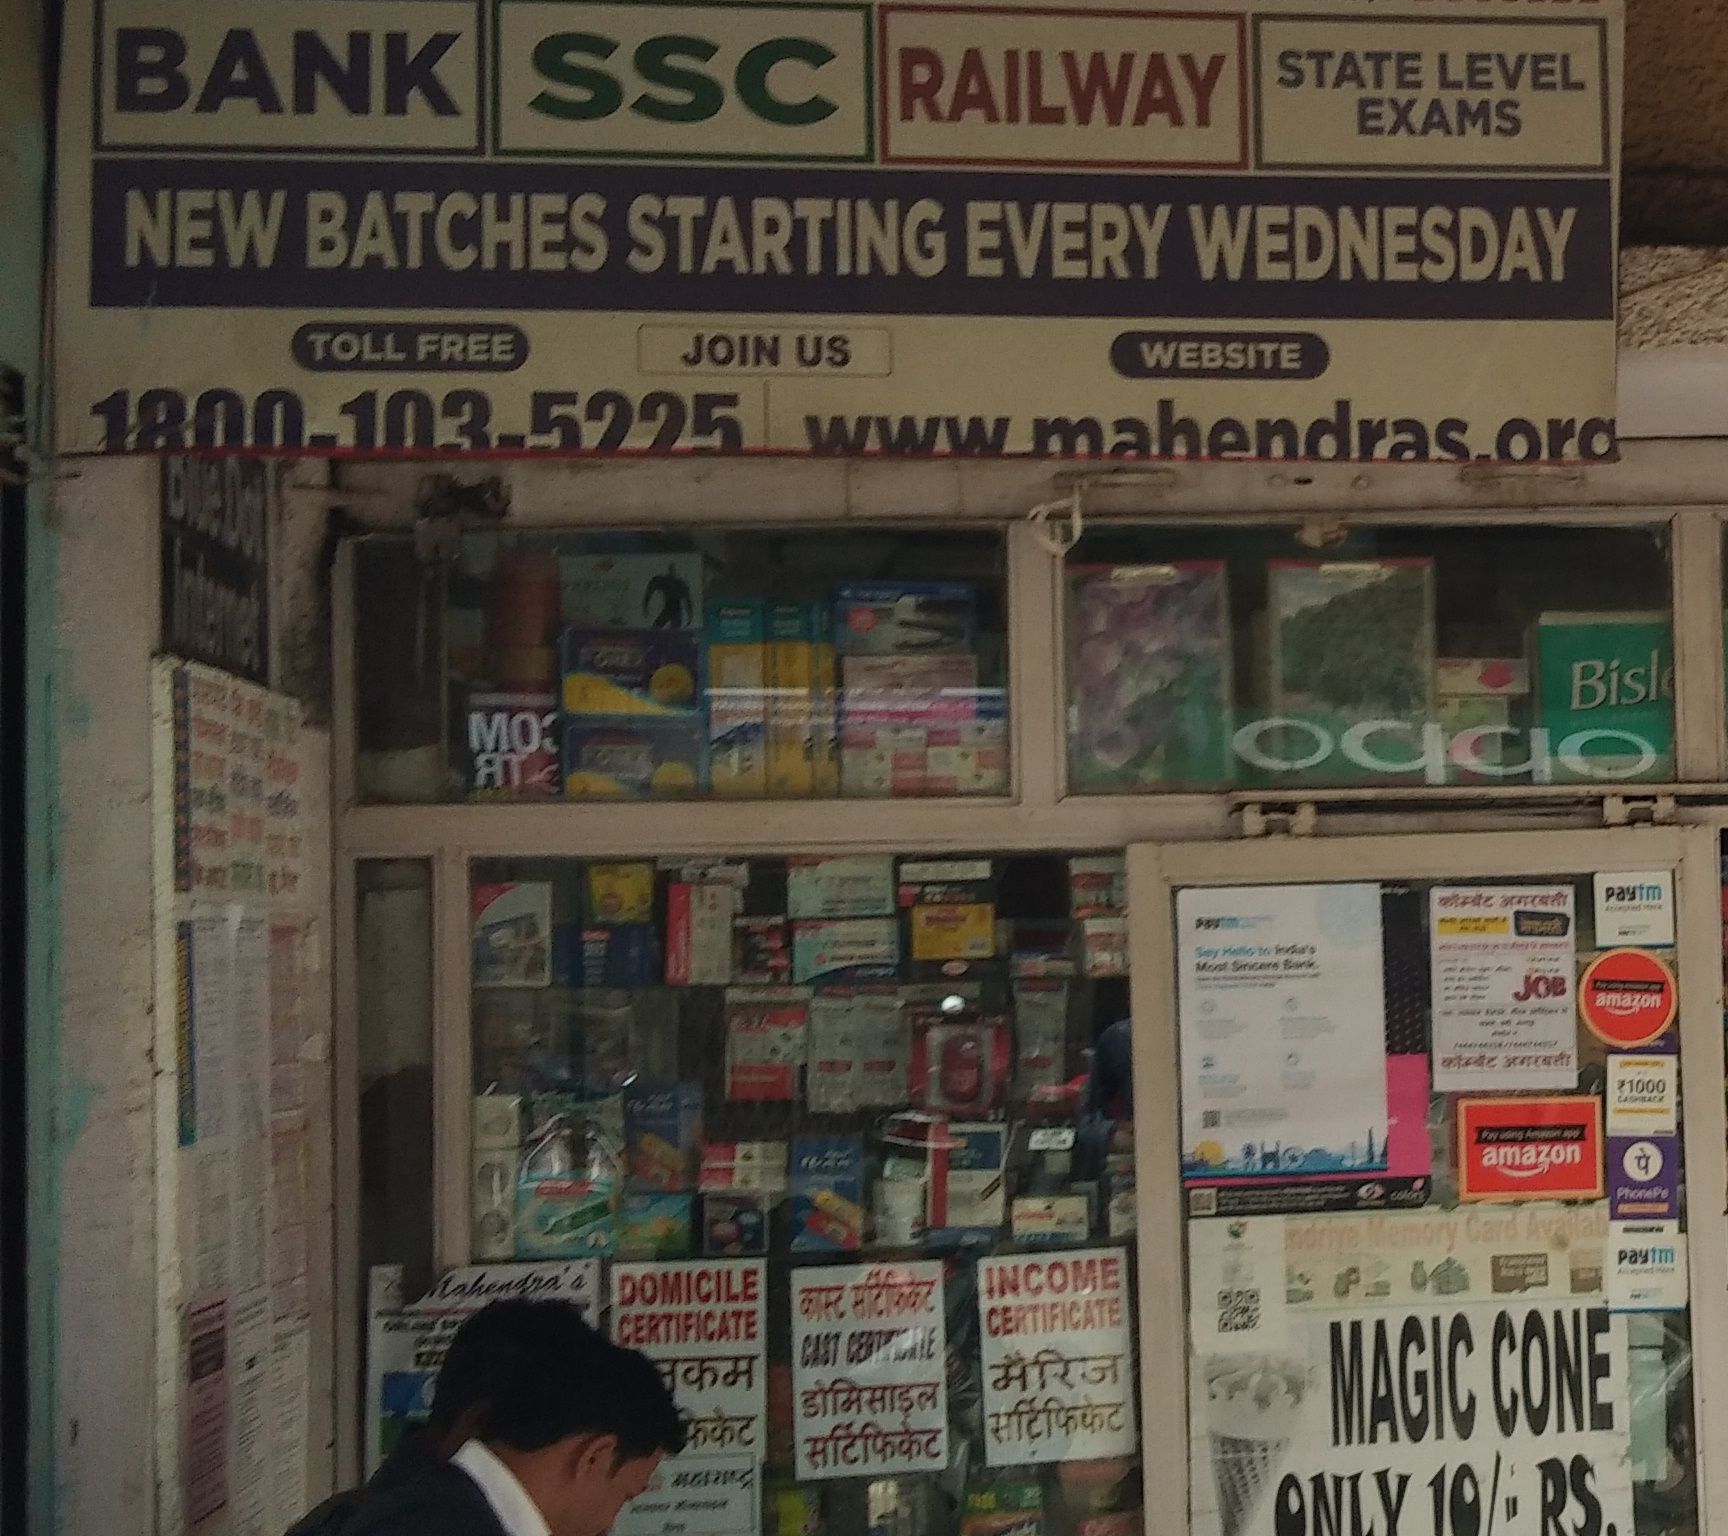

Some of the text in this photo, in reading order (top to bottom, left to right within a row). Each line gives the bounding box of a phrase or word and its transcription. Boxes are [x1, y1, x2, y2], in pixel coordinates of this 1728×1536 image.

[113, 25, 464, 117] BANK
[528, 30, 841, 128] SSC
[897, 46, 1228, 130] RAILWAY
[1275, 50, 1587, 95] STATE LEVEL
[1356, 98, 1524, 138] EXAMS
[123, 187, 1580, 285] NEW BATCHES STARTING EVERY WEDNESDAY
[305, 331, 517, 364] TOLL FREE
[680, 332, 852, 369] JOIN US
[1139, 341, 1303, 373] WEBSITE
[88, 387, 746, 455] 1800-103-5225
[1512, 973, 1567, 1002] JOB
[1595, 992, 1661, 1009] amazon
[1481, 1141, 1582, 1170] amazon
[1616, 1186, 1669, 1201] PhonePe
[1617, 1247, 1675, 1266] paytm
[618, 1269, 760, 1307] DOMICILE
[985, 1257, 1121, 1299] INCOME
[616, 1309, 759, 1346] CERTIFICATE
[985, 1296, 1121, 1339] CERTIFICATE
[1328, 1306, 1615, 1449] MAGIC CONE
